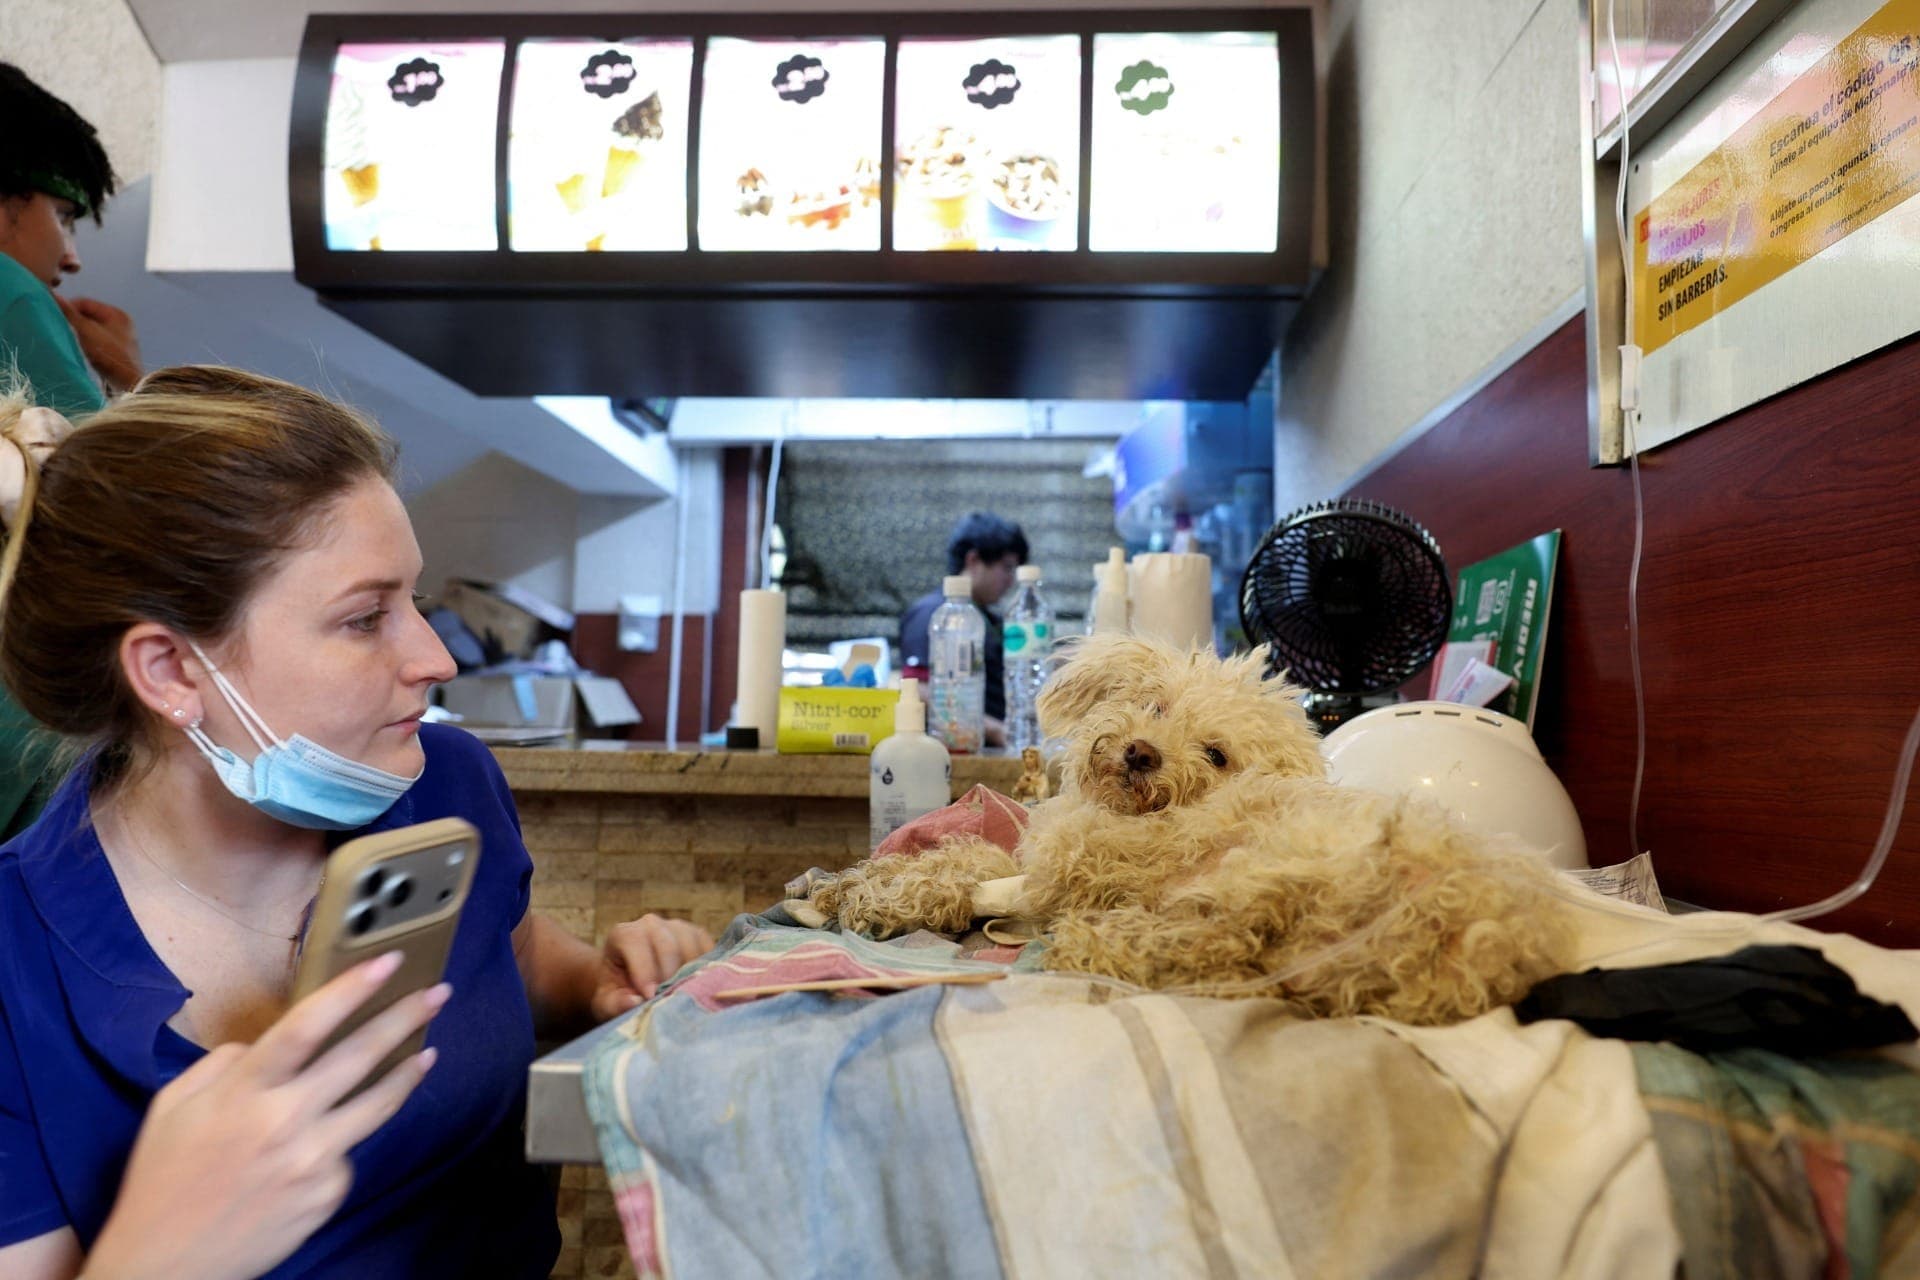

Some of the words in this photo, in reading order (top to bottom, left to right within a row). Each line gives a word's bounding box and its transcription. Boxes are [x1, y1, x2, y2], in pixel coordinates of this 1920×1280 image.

[1769, 110, 1819, 158] Escanea
[1822, 93, 1834, 116] el
[1837, 60, 1884, 105] código
[1888, 34, 1911, 64] QR
[1798, 142, 1807, 158] al
[1807, 119, 1839, 149] equipo
[1809, 177, 1829, 199] poco
[1837, 151, 1869, 177] apunta
[1880, 115, 1918, 147] cámara
[1769, 228, 1776, 239] o
[1776, 210, 1805, 234] ingresa
[1805, 201, 1814, 216] al
[1658, 298, 1674, 321] SIN
[1675, 263, 1728, 311] BARRERAS.
[793, 702, 882, 719] Nitri-cor
